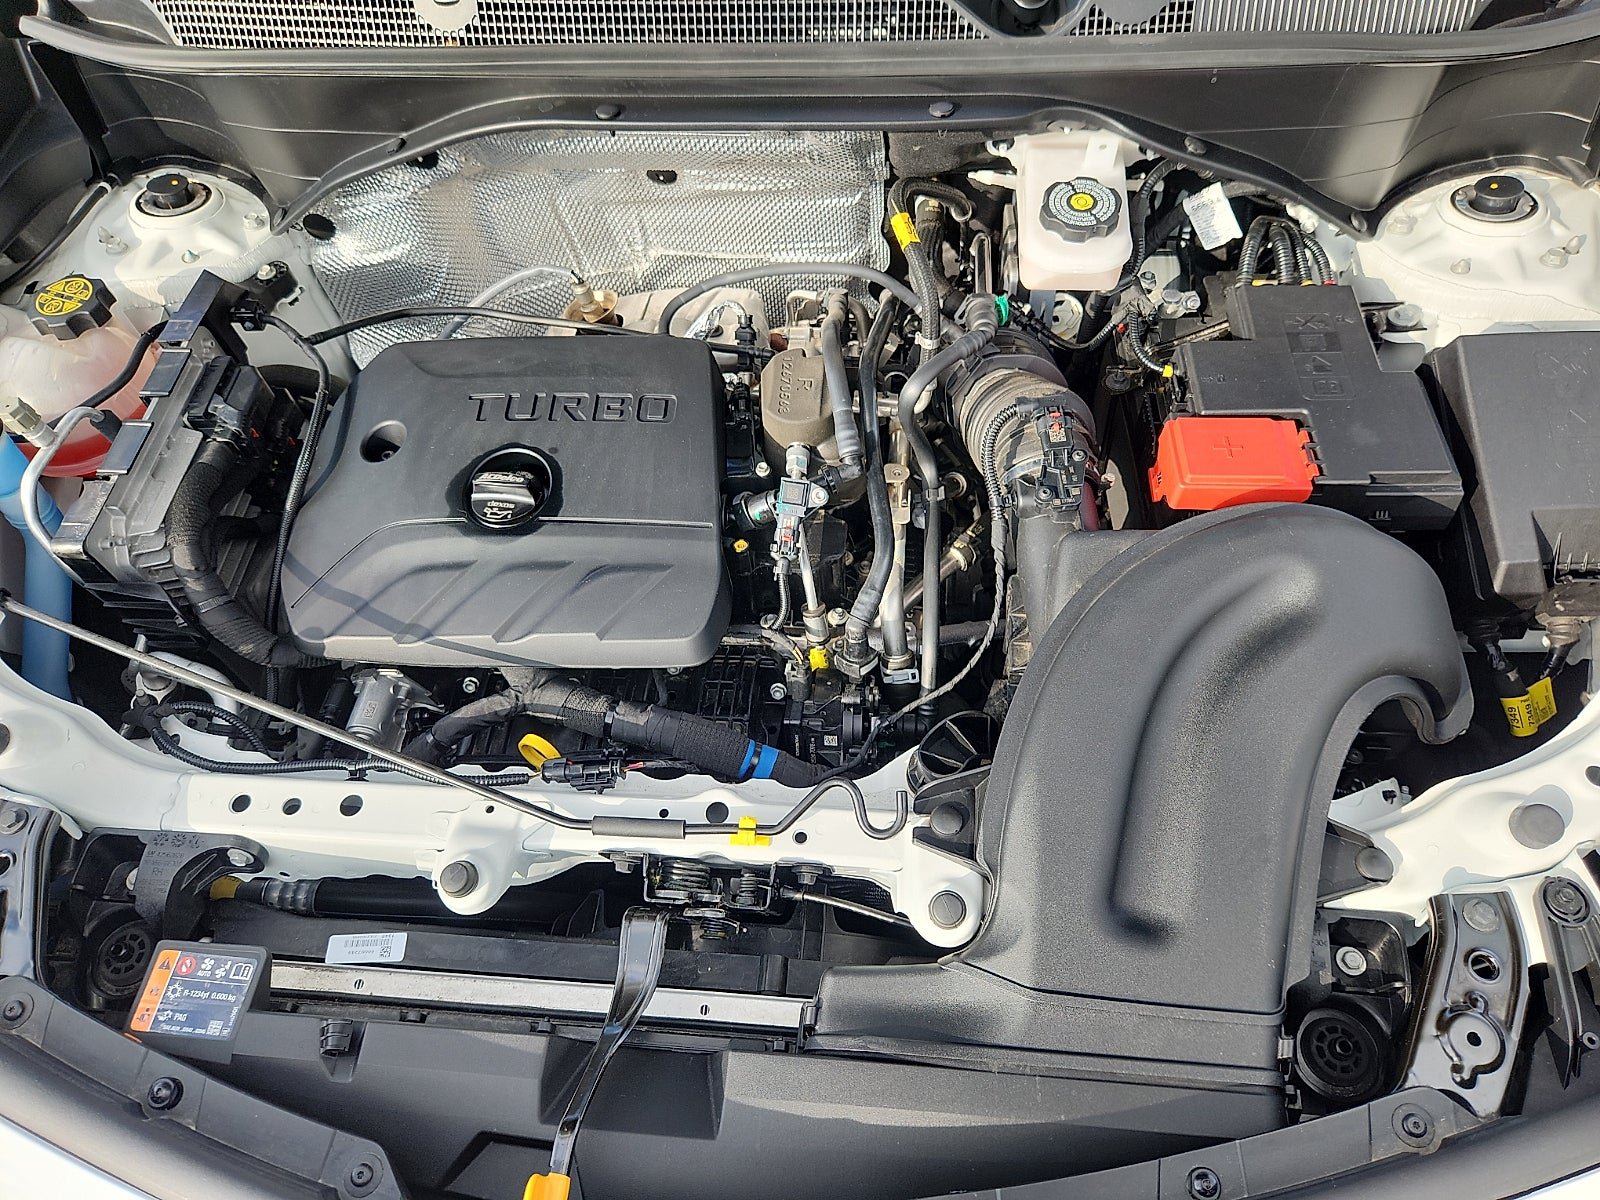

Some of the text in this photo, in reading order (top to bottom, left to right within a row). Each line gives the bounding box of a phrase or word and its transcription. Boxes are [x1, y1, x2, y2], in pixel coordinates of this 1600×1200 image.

[468, 391, 678, 424] TURBO
[487, 500, 515, 509] dexos
[1508, 707, 1520, 729] 7349
[1525, 703, 1535, 727] 7349
[183, 989, 210, 1000] R-1234yf
[174, 1012, 187, 1021] PAG
